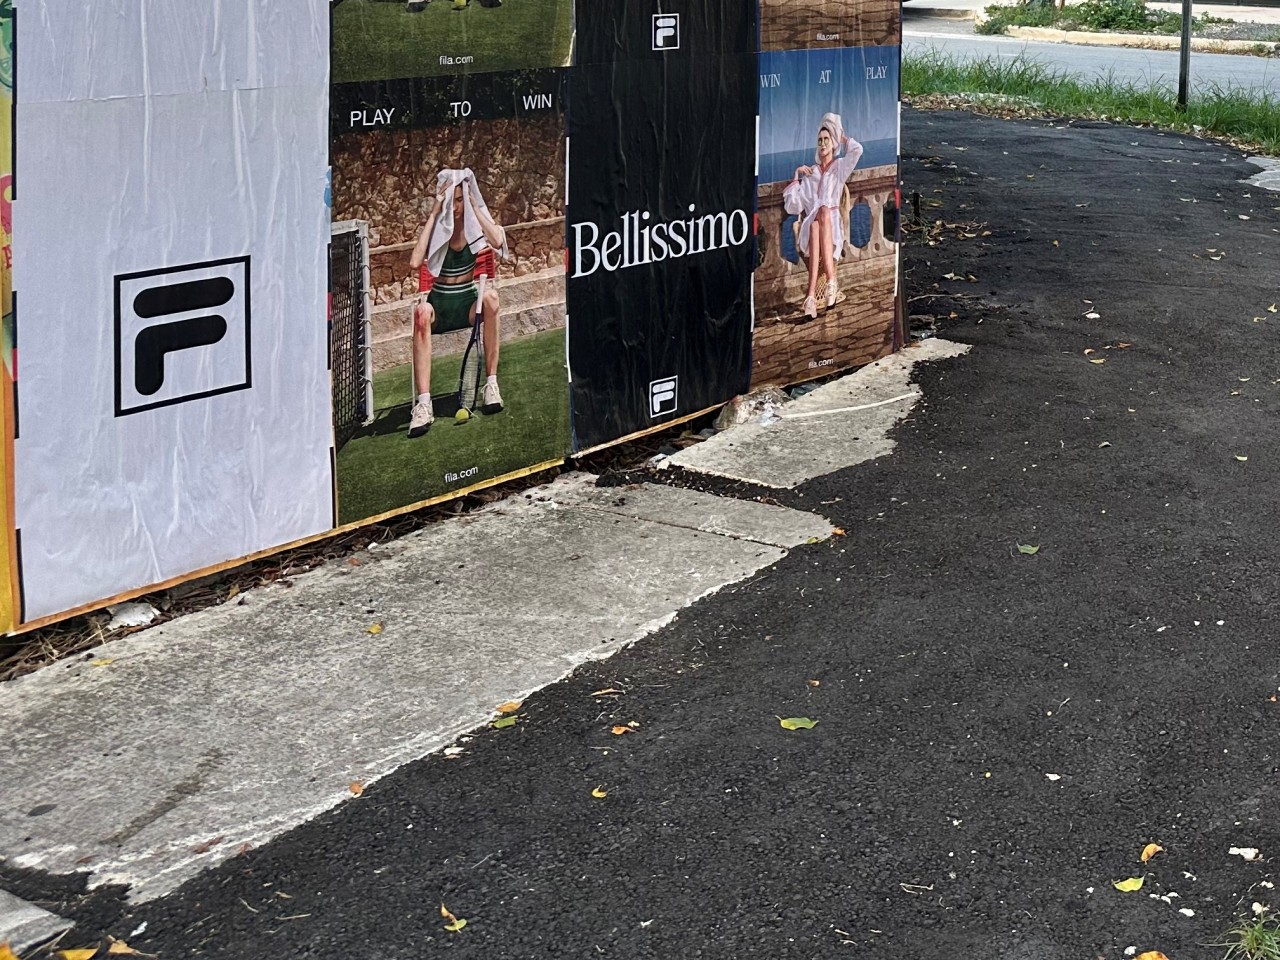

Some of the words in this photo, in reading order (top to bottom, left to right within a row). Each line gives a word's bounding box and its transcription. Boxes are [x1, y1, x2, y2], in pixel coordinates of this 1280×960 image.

[439, 55, 474, 65] fila.com
[760, 73, 781, 89] WIN
[818, 69, 832, 84] AT
[865, 65, 888, 80] PLAY
[349, 107, 396, 127] PLAY
[450, 100, 472, 118] TO
[522, 93, 552, 111] WIN
[570, 203, 749, 279] Bellissimo
[444, 466, 479, 483] fila.com
